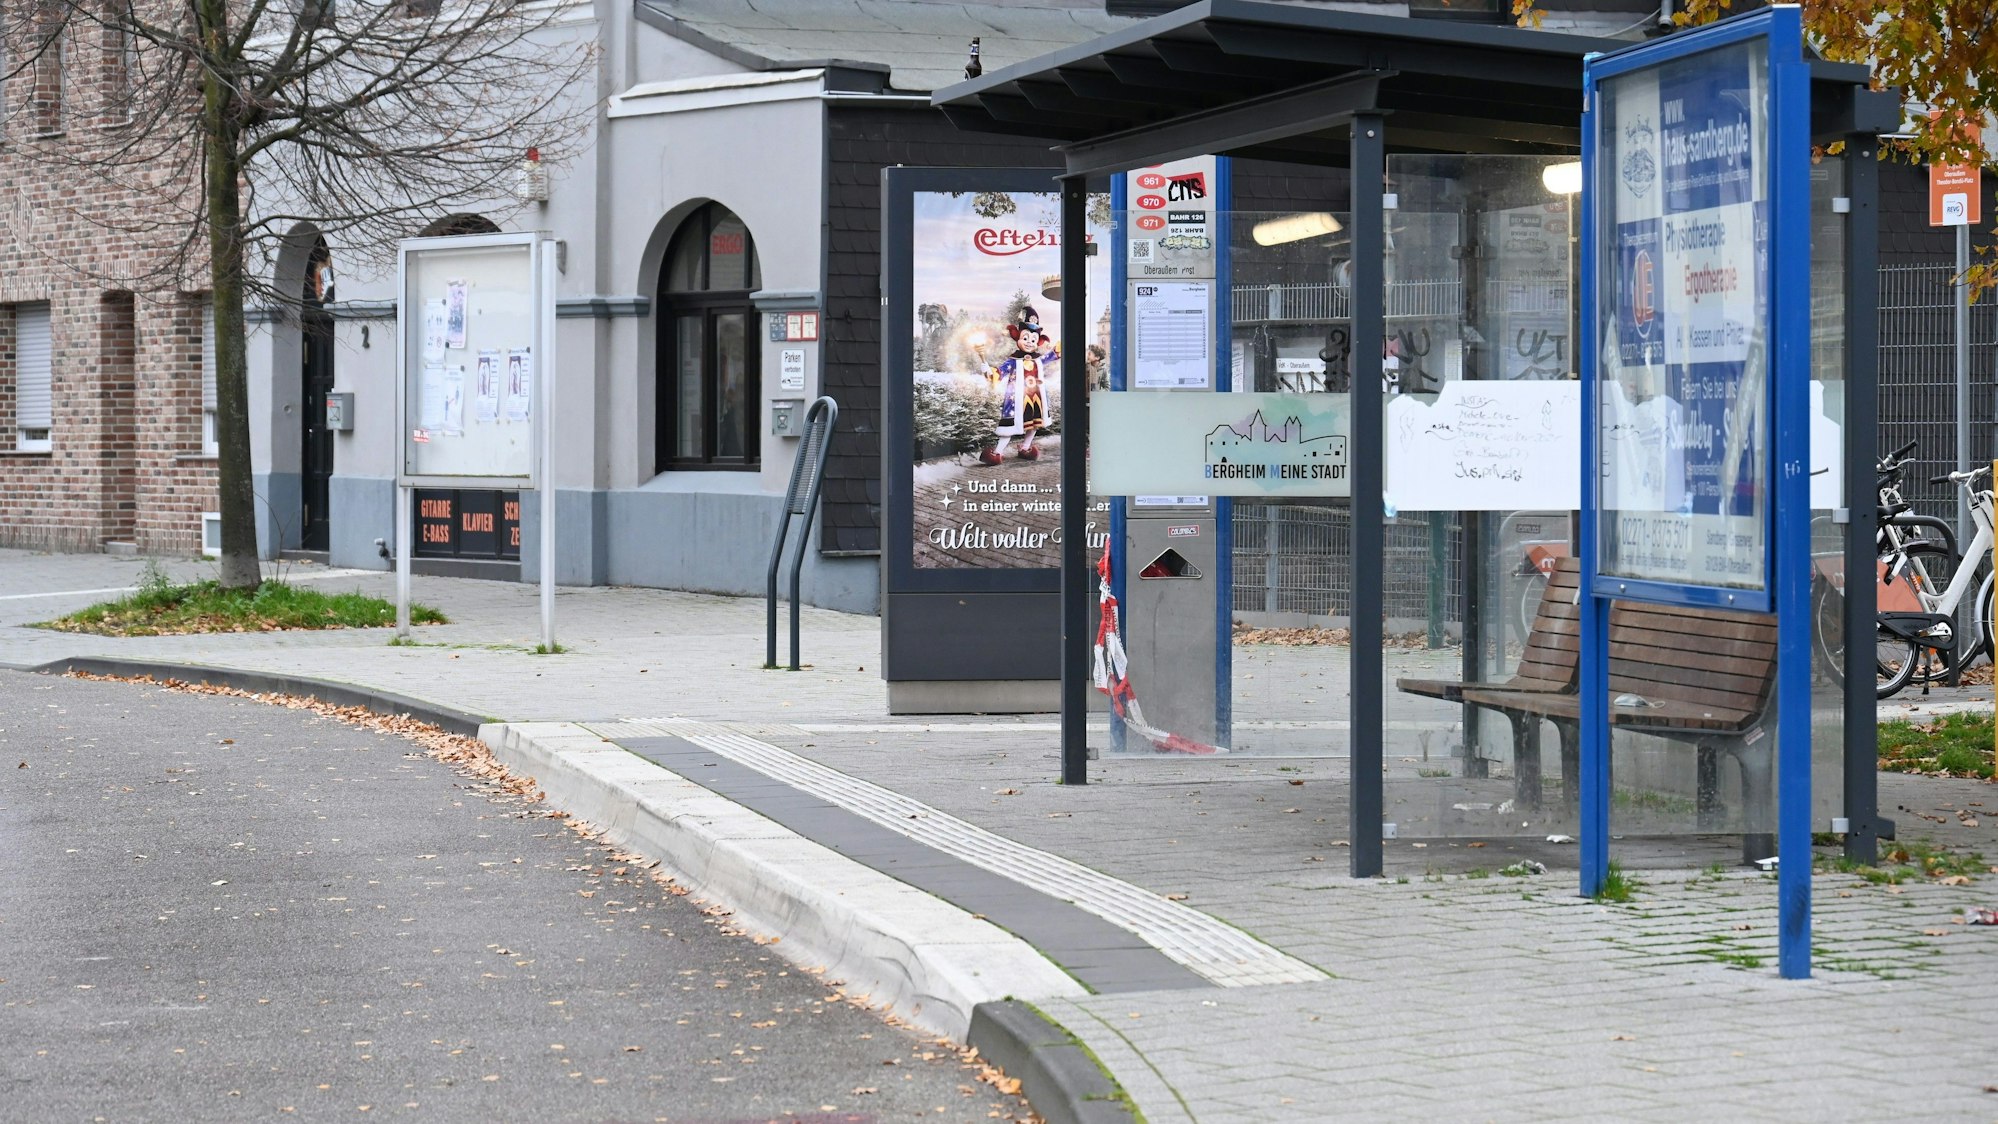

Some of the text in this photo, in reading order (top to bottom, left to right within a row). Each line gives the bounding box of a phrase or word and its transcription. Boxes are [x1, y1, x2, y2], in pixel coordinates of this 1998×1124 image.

[1664, 99, 1686, 124] www.
[1664, 112, 1749, 167] haus-sandberg.de
[1144, 177, 1159, 185] 961
[1168, 178, 1205, 201] CNS
[1143, 198, 1159, 206] 970
[1947, 205, 1960, 213] REVG
[1143, 219, 1159, 227] 971
[1665, 214, 1726, 259] Physiotherapie
[1144, 265, 1178, 275] Oberaußem
[1685, 257, 1738, 303] Ergotherapie
[1139, 287, 1151, 295] 924
[361, 325, 370, 349] 2
[785, 352, 801, 362] Parken
[1204, 464, 1347, 479] BERGHEIM MEINE STADT
[1785, 460, 1800, 479] Hi
[968, 479, 997, 493] Und
[1000, 479, 1037, 493] dann
[421, 500, 451, 518] GITARRE
[963, 500, 978, 512] in
[981, 499, 1019, 512] einer
[463, 513, 493, 532] KLAVIER
[423, 524, 449, 543] E-BASS
[929, 522, 990, 550] Welt
[992, 526, 1048, 550] voller
[1622, 518, 1646, 546] 02271
